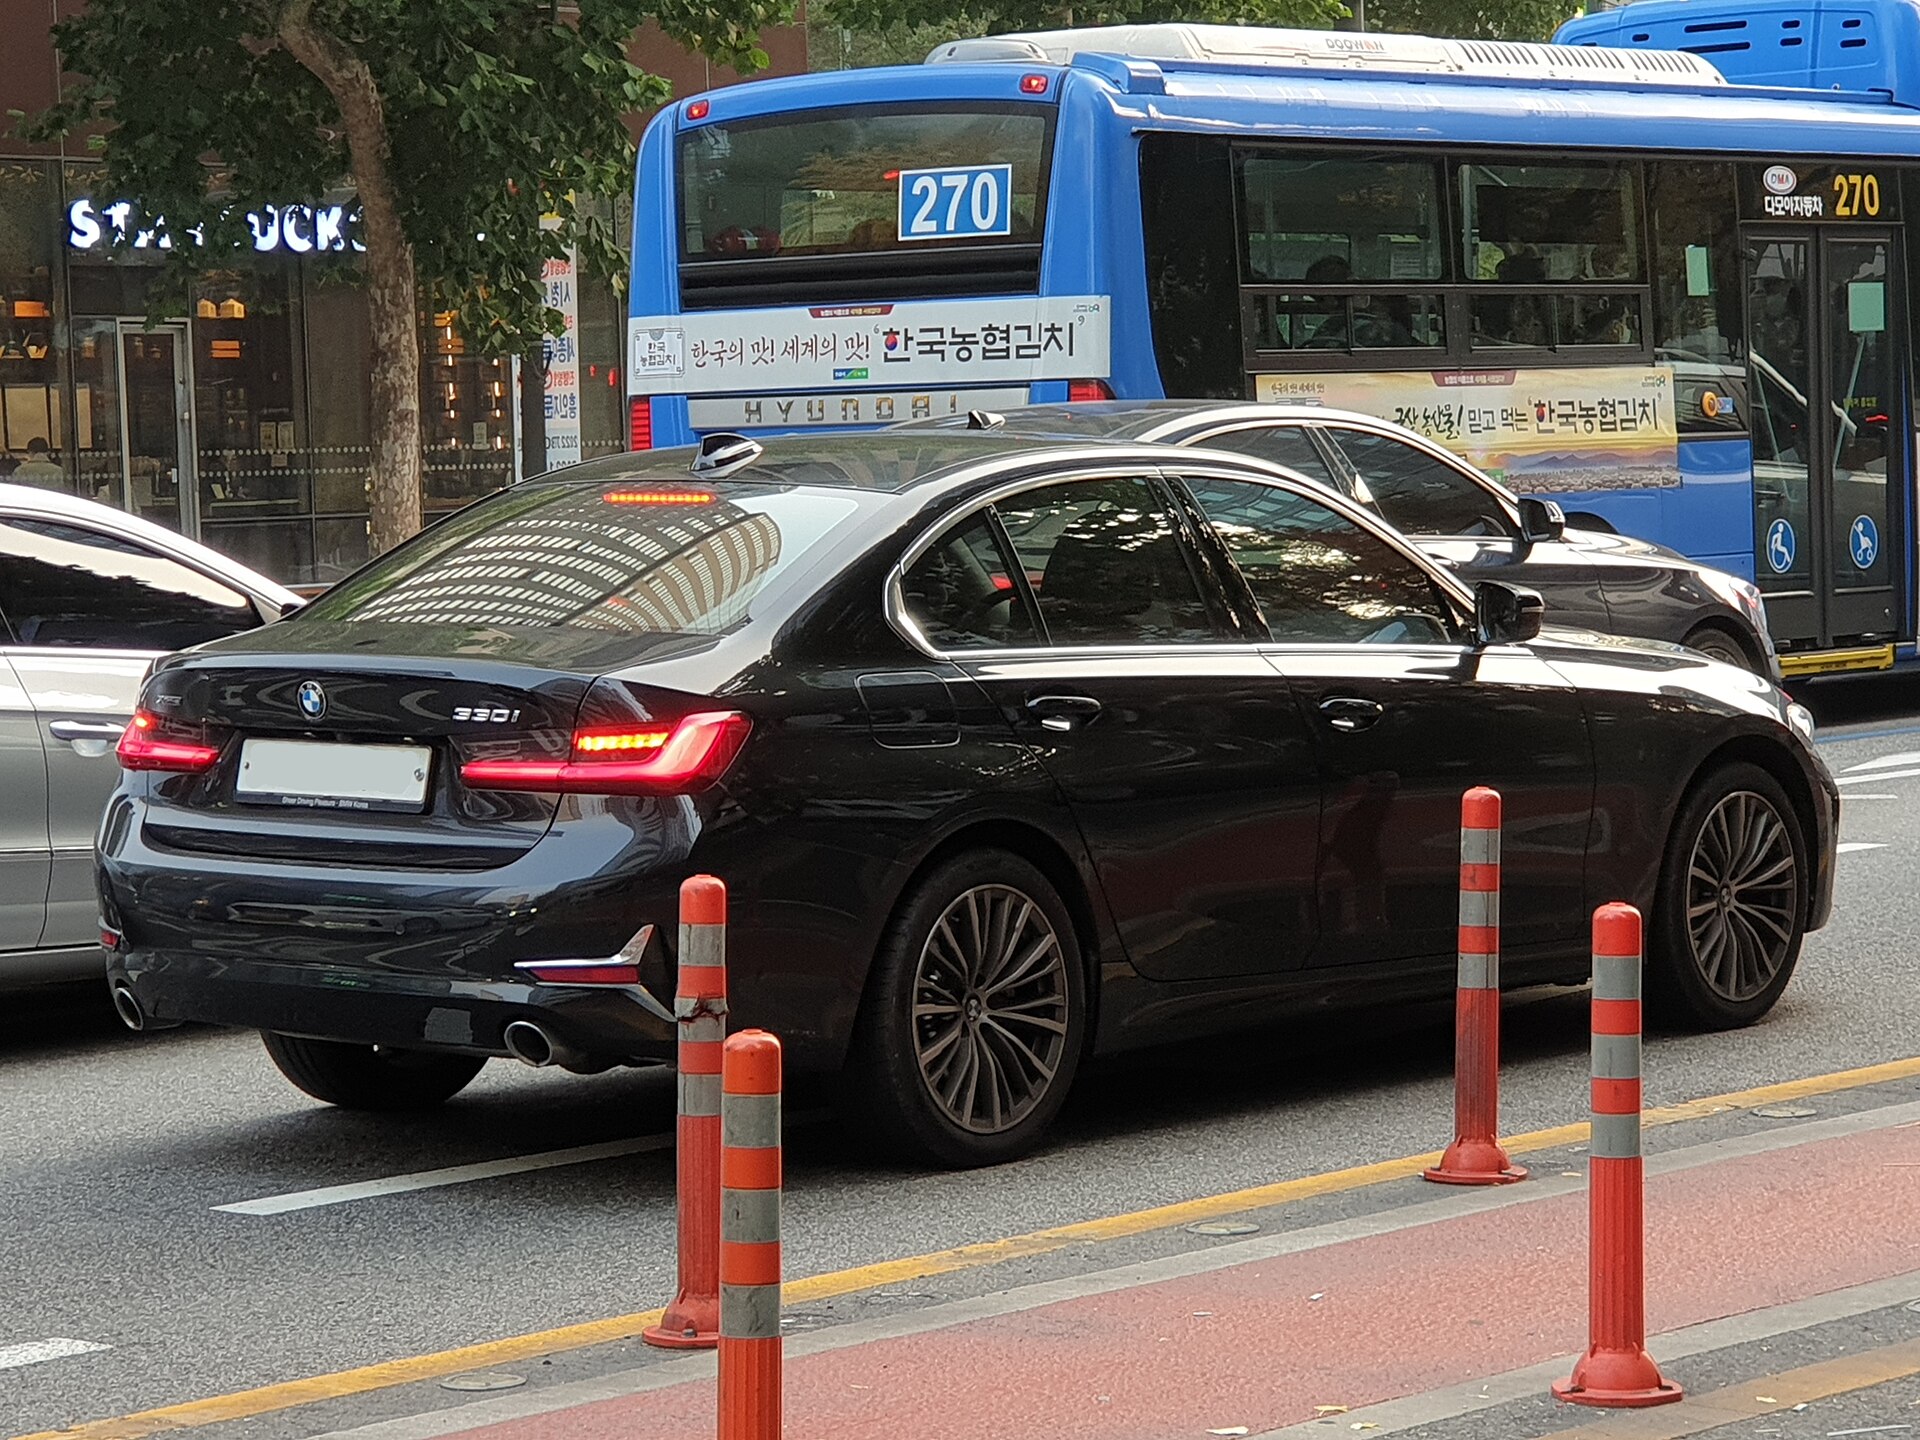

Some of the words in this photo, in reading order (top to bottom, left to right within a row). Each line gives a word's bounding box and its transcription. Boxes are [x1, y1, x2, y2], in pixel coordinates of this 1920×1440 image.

[910, 171, 998, 233] 270
[1764, 196, 1823, 217] 다모아자동차
[1833, 174, 1880, 216] 270
[648, 341, 666, 354] 한국
[691, 337, 744, 369] 한국의
[750, 335, 776, 366] 맛!
[780, 332, 837, 363] 세계의
[844, 331, 870, 361] 맛!
[744, 394, 957, 423] HYUNDAI
[1468, 408, 1496, 434] 믿고
[1501, 407, 1528, 432] 먹는
[452, 706, 521, 723] 330i
